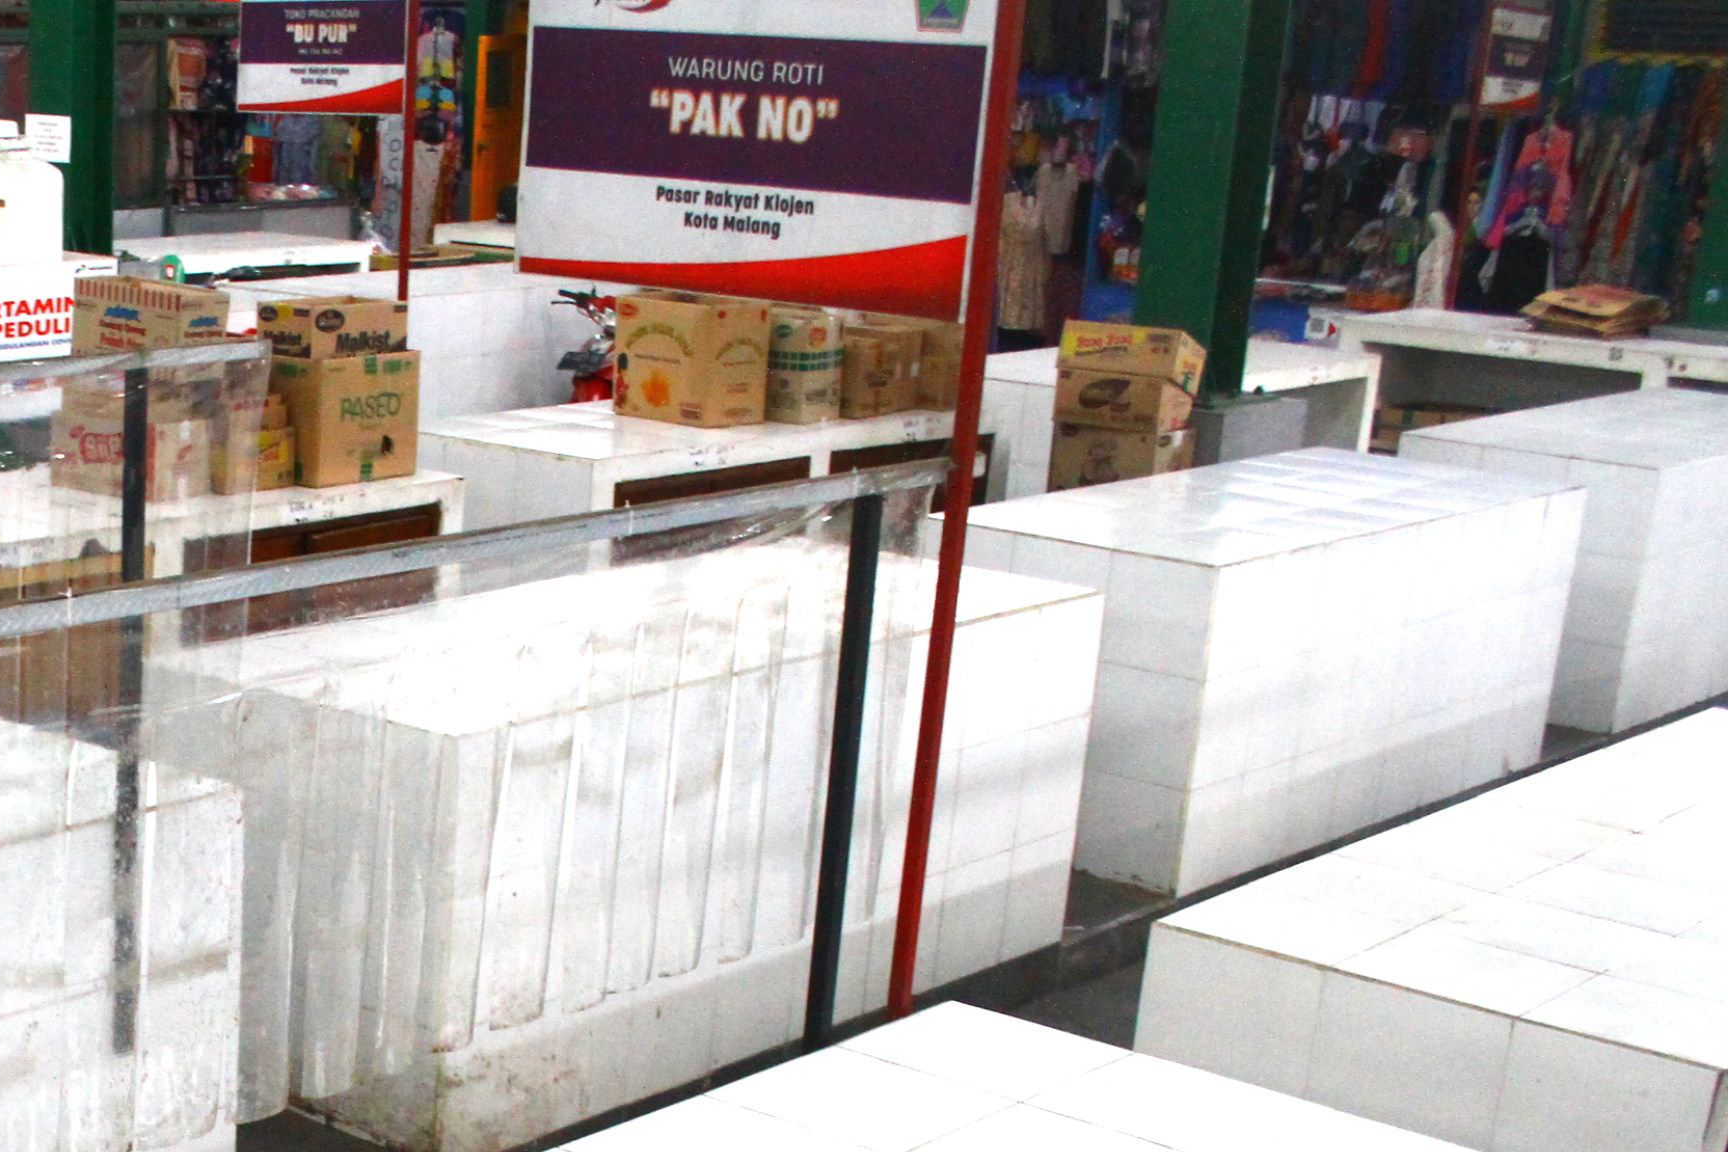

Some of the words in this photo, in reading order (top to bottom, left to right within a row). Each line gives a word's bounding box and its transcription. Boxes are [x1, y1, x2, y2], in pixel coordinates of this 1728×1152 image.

[669, 56, 765, 82] WARUNG
[772, 61, 824, 86] ROTI
[650, 88, 747, 138] "PAK
[756, 95, 840, 144] NO"
[656, 185, 700, 204] Pasar
[705, 189, 759, 212] Rakyat
[764, 194, 815, 216] Klojen
[684, 211, 718, 230] Kota
[723, 215, 781, 240] Malang
[336, 331, 390, 353] Malkist
[340, 392, 401, 423] PASEO
